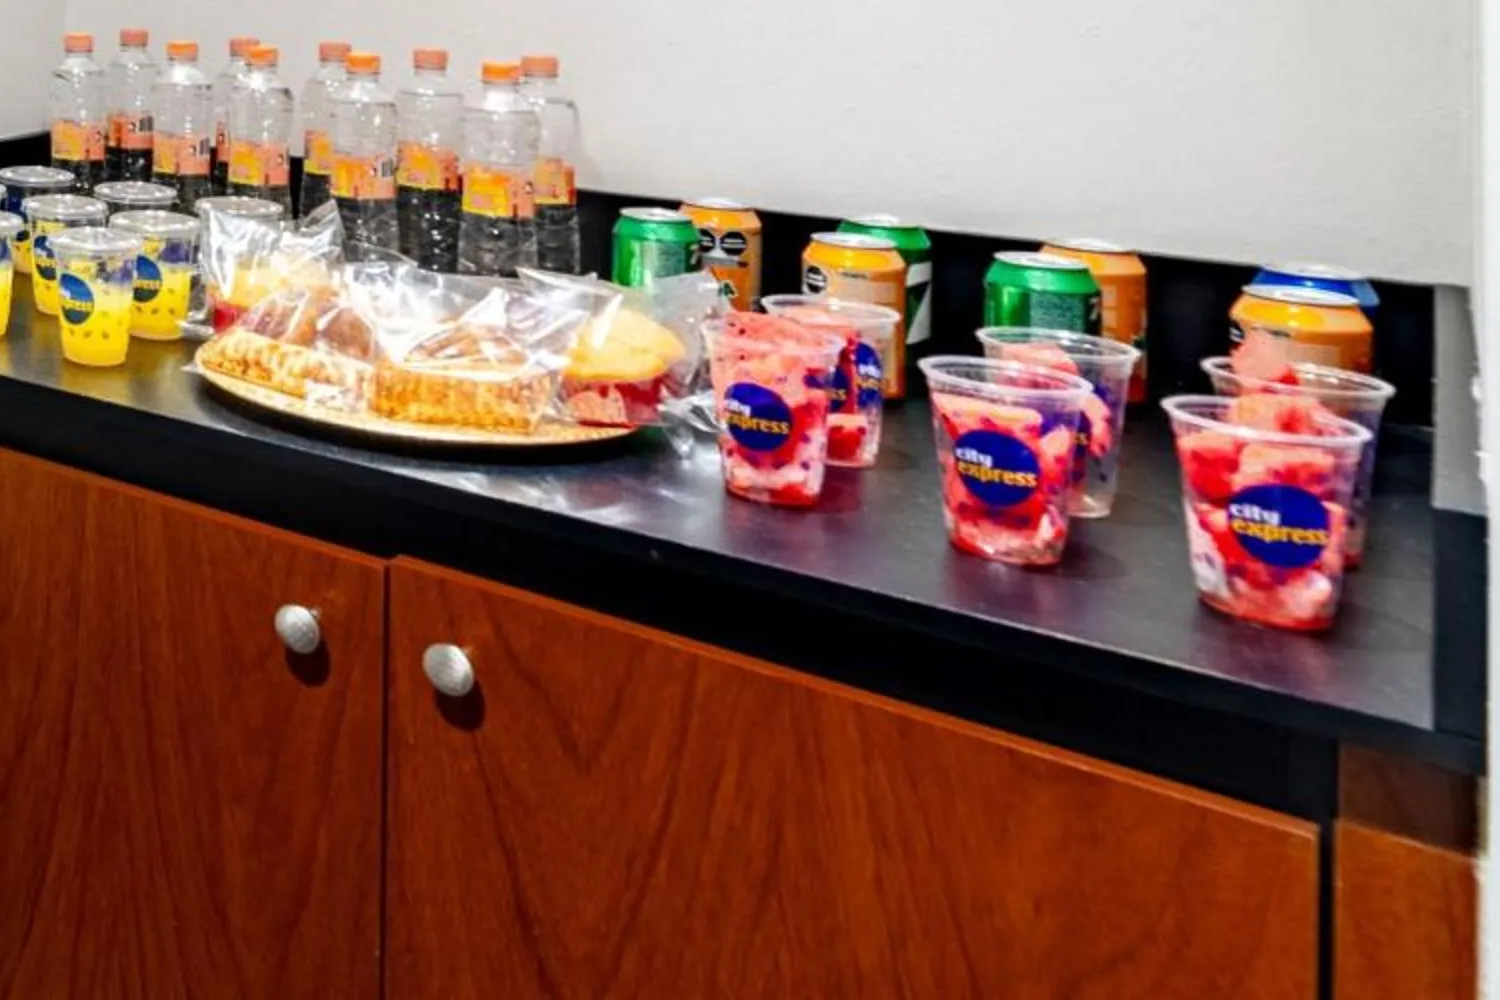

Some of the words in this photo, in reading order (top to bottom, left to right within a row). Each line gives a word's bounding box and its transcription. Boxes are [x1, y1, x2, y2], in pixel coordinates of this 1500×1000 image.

[955, 447, 993, 467] city
[958, 461, 1037, 488] express
[1229, 503, 1281, 525] city
[1231, 519, 1329, 545] express
